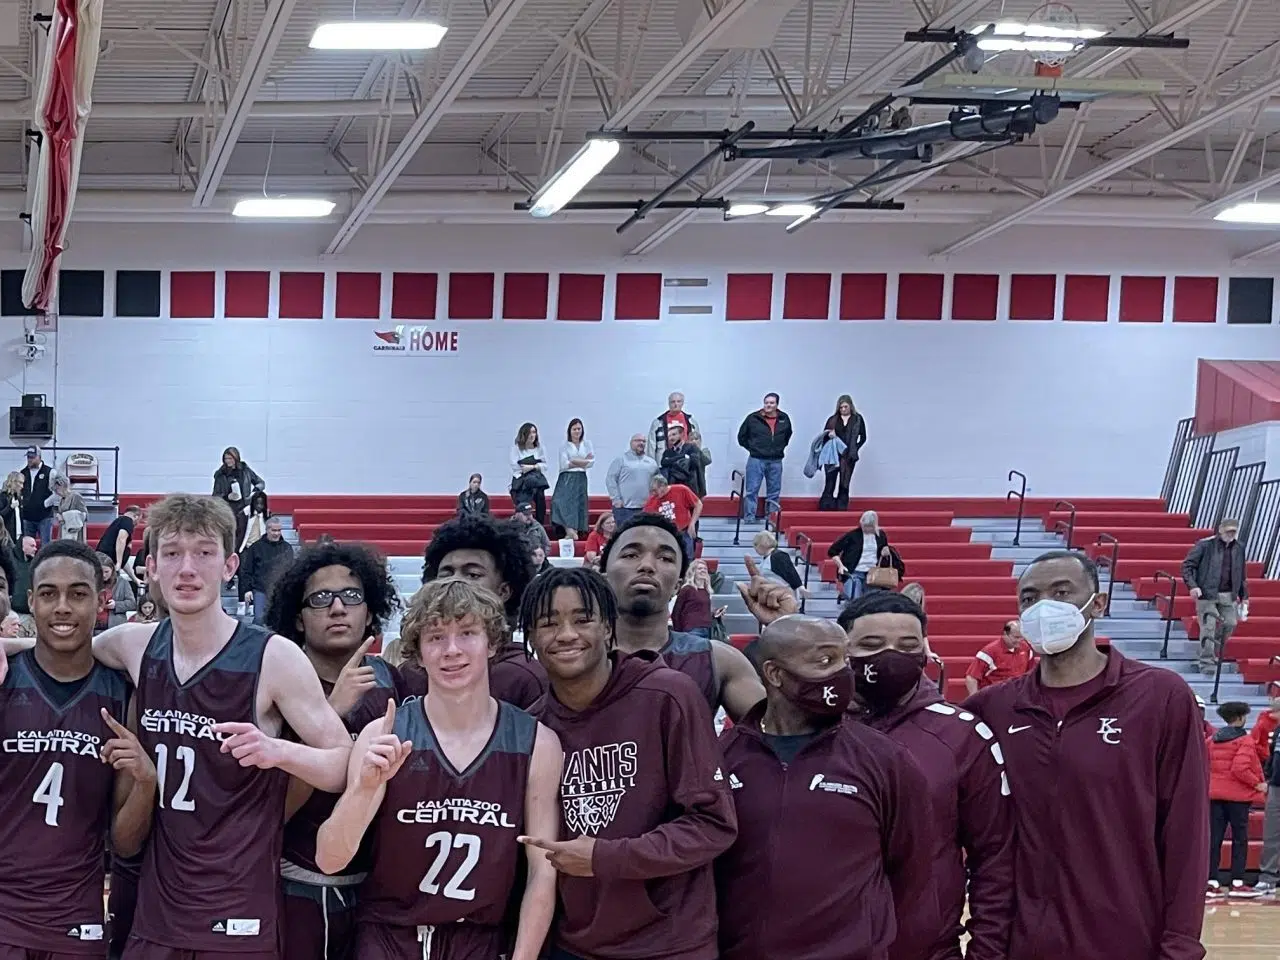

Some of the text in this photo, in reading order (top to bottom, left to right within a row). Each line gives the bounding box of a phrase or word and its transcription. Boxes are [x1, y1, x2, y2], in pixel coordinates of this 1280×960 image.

[409, 331, 458, 351] HOME
[17, 729, 101, 745] KALAMAZOO
[1096, 717, 1122, 744] KC
[2, 737, 104, 759] CENTRA
[562, 741, 638, 786] ANTS
[154, 743, 196, 812] 12
[561, 777, 636, 796] KETBALL
[32, 761, 65, 827] 4
[416, 798, 502, 812] KALAMAZOO
[396, 806, 516, 828] CENTRAL
[418, 830, 482, 901] 22
